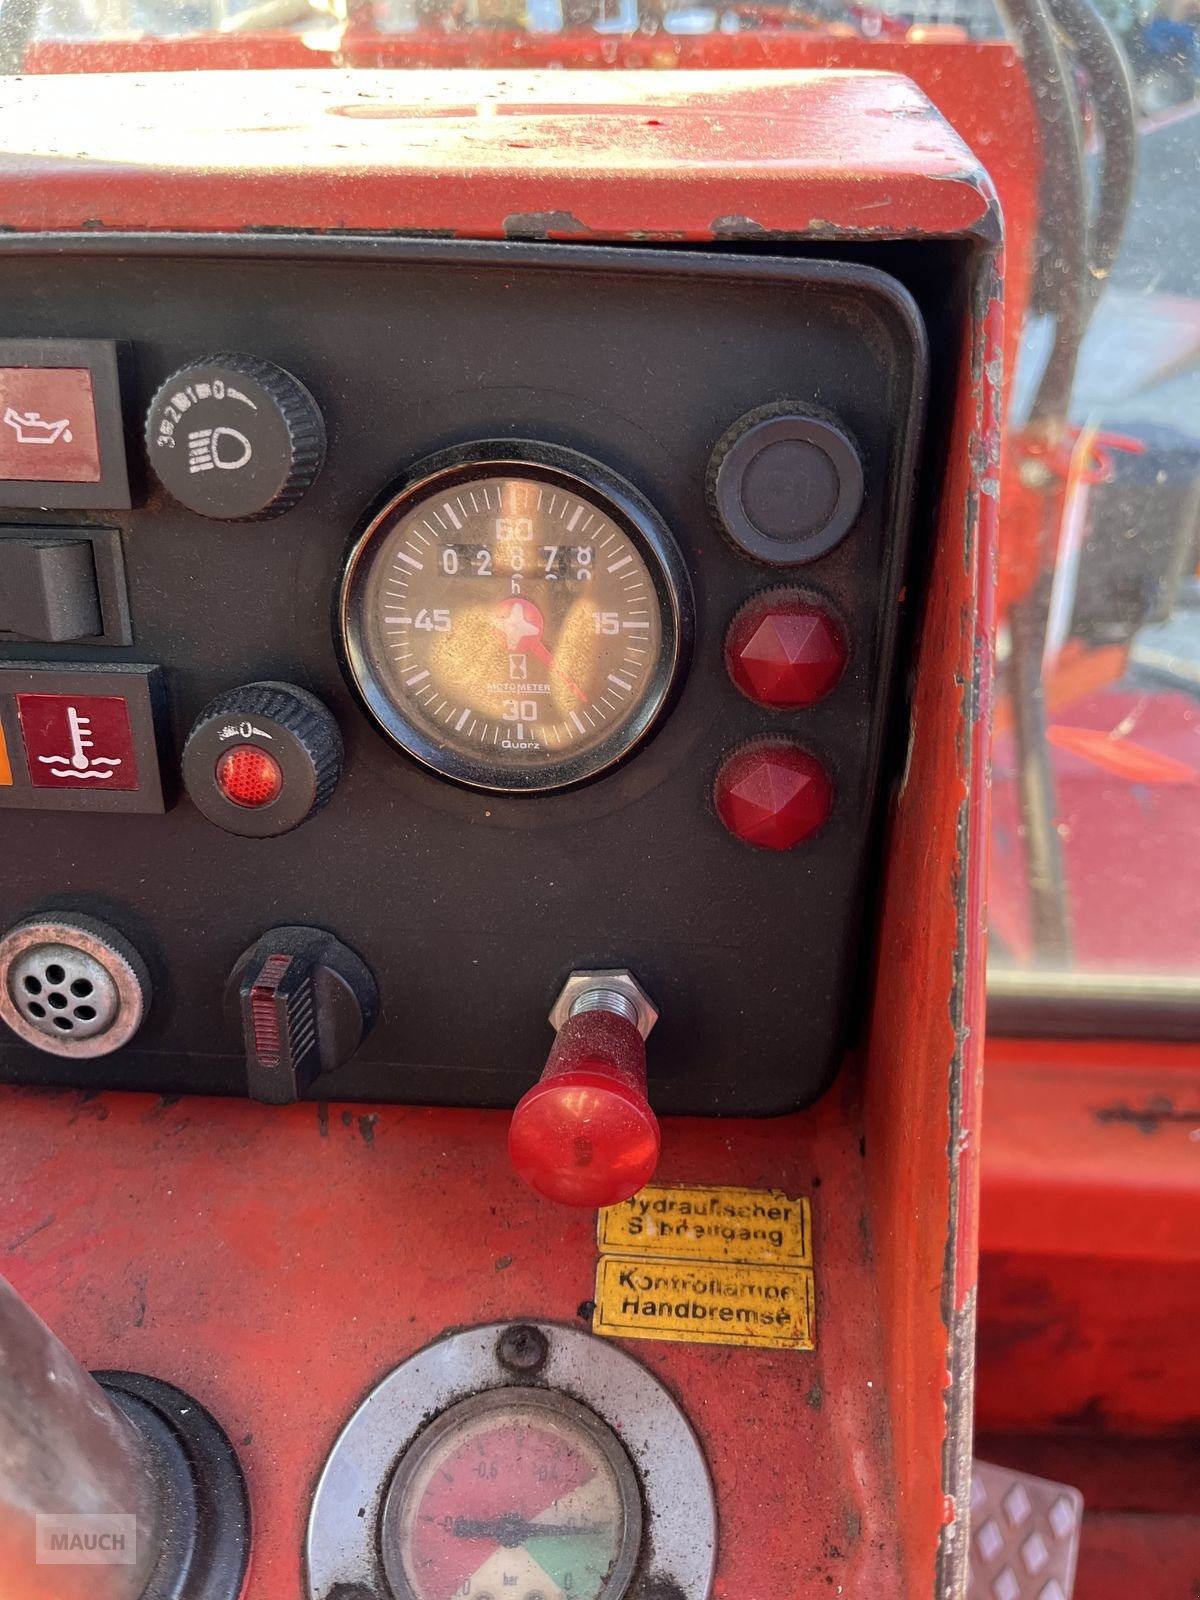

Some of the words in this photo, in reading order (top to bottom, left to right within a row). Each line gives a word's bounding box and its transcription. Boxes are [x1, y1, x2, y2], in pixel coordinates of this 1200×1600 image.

[415, 608, 451, 632] 45
[592, 612, 620, 635] 15
[502, 700, 537, 721] 30
[622, 1295, 792, 1326] Handbremse
[503, 1572, 519, 1586] bar
